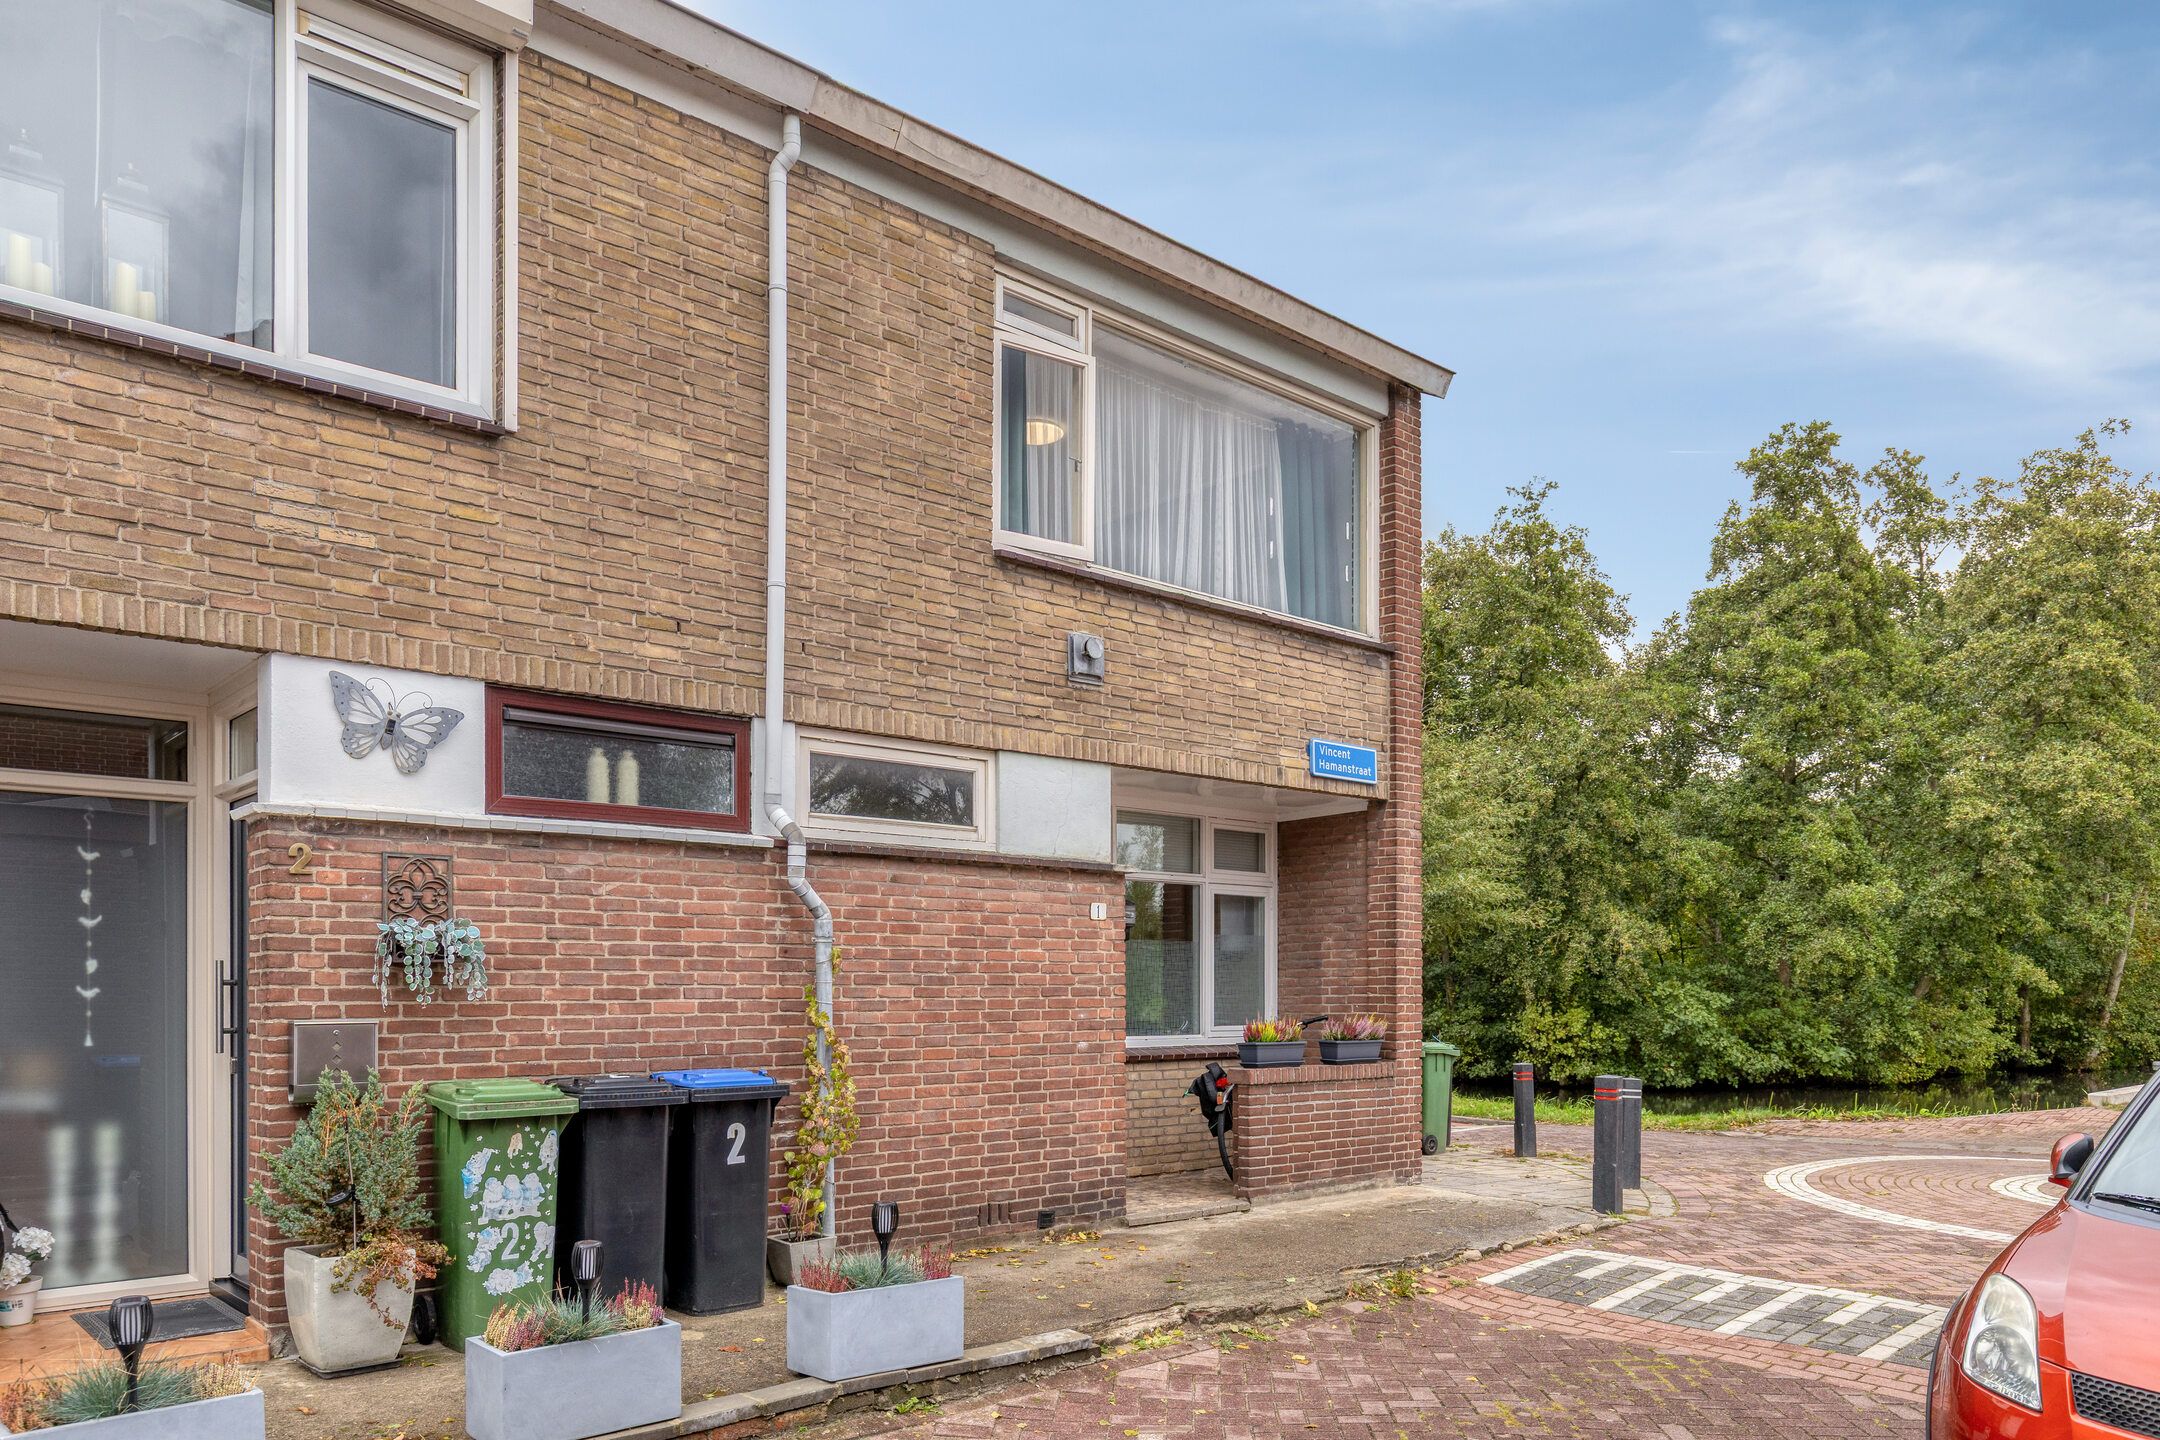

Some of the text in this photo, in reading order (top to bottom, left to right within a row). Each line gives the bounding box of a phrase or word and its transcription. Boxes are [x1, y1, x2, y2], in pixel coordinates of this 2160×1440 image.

[1319, 744, 1351, 760] Vincent
[1319, 759, 1372, 777] Hamanstraat
[288, 842, 312, 874] 2
[727, 1122, 746, 1165] 2
[501, 1222, 519, 1260] 2
